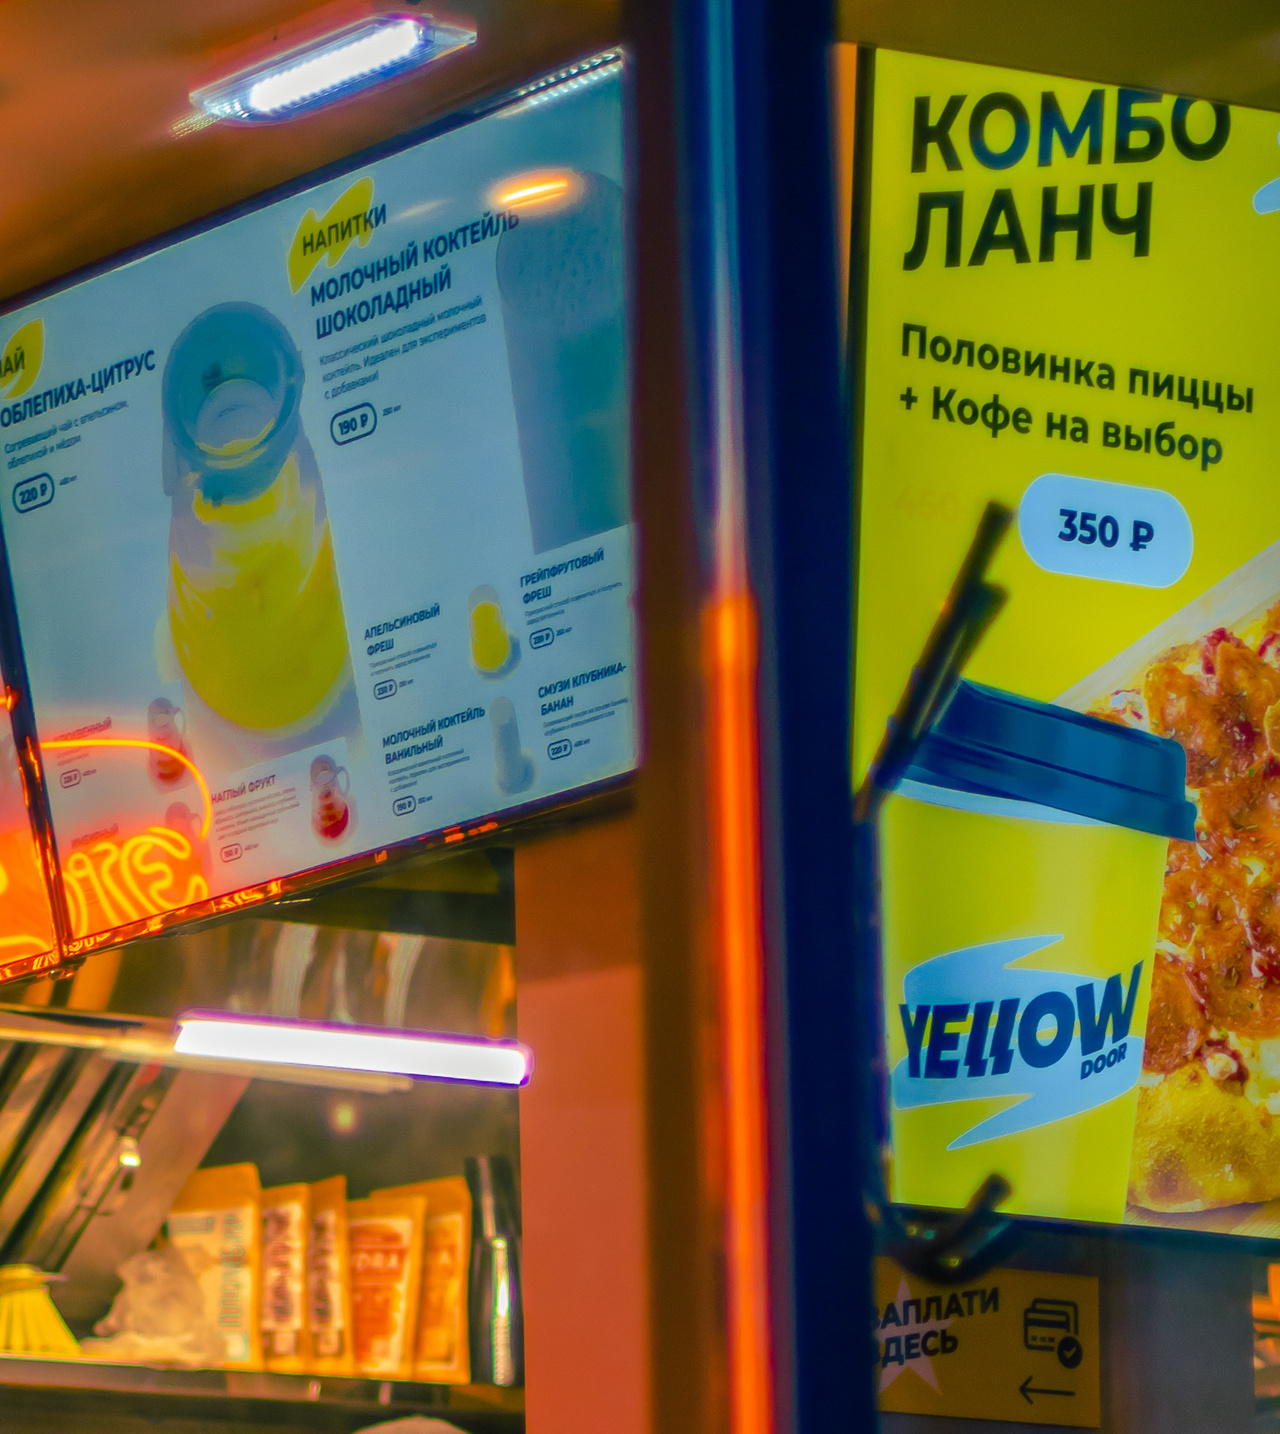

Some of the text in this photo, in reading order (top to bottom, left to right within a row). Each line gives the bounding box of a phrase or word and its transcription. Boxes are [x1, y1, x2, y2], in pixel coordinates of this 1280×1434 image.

[910, 87, 1232, 174] КОМБО
[302, 203, 387, 256] НАПИТКИ
[902, 180, 1154, 271] ЛАНЧ
[310, 209, 520, 306] МОЛОЧНЫЙ КОКТЕЙЛЬ
[315, 263, 452, 340] ШОКОЛАДНЫЙ
[901, 321, 1255, 415] Половинка пиццы
[0, 350, 156, 428] ОБЛЕПИХА-ЦИТРУС
[338, 416, 357, 436] 190
[931, 385, 1034, 438] Кофе
[1046, 412, 1089, 445] на
[1102, 420, 1224, 472] выбор
[18, 487, 38, 505] 220
[1058, 507, 1155, 552] 350 ₽
[520, 549, 604, 587] ГРЕЙПФРУТОВЫЙ
[523, 585, 551, 604] ФРЕШ
[364, 603, 440, 640] АПЕЛЬСИНОВЫЙ
[367, 638, 394, 656] ФРЕШ
[538, 662, 626, 698] СМУЗИ КЛУБНИКА-
[541, 695, 573, 715] БАНАН
[382, 706, 486, 748] МОЛОЧНЫЙ КОКТЕЙЛЬ
[385, 735, 443, 764] ВАНИЛЬНЫЙ
[248, 774, 276, 792] ФРУКТ
[900, 959, 1144, 1079] YELLOW
[1080, 1042, 1128, 1081] DOOR
